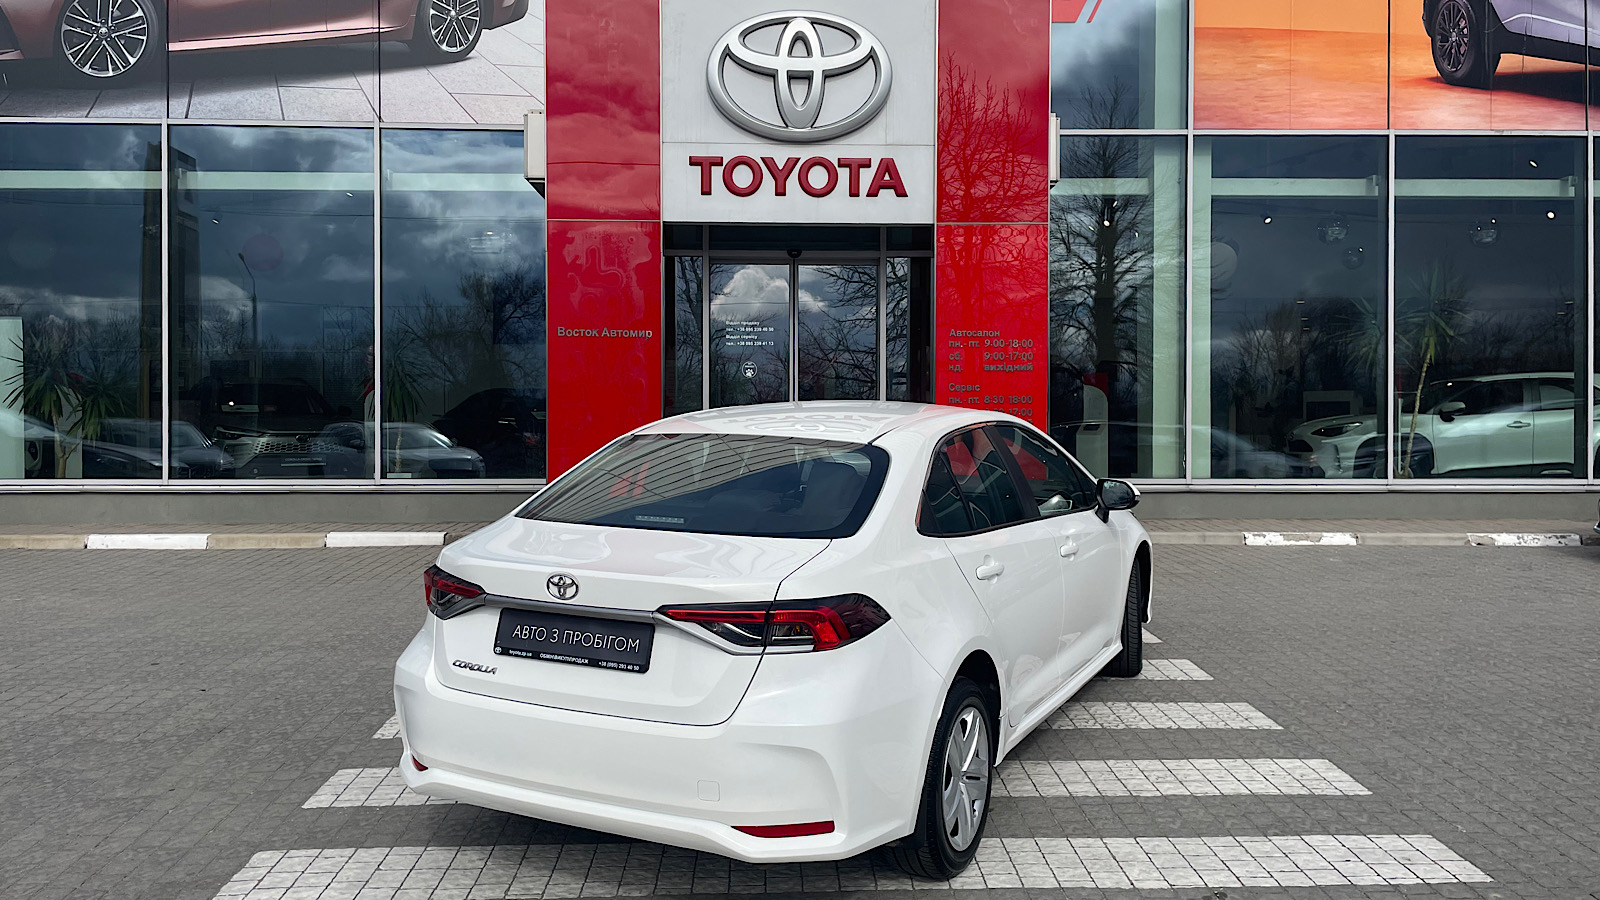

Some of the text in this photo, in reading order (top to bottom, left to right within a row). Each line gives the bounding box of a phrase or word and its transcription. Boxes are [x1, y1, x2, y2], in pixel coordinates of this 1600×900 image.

[689, 155, 908, 198] TOYOTA
[557, 326, 653, 340] Восток Автомир
[950, 328, 1000, 337] Автосалон
[984, 362, 1033, 372] вихідний
[948, 383, 980, 392] Сервіс
[512, 624, 640, 652] АВТО З ПРОБІГОМ
[452, 660, 498, 674] COROLLA
